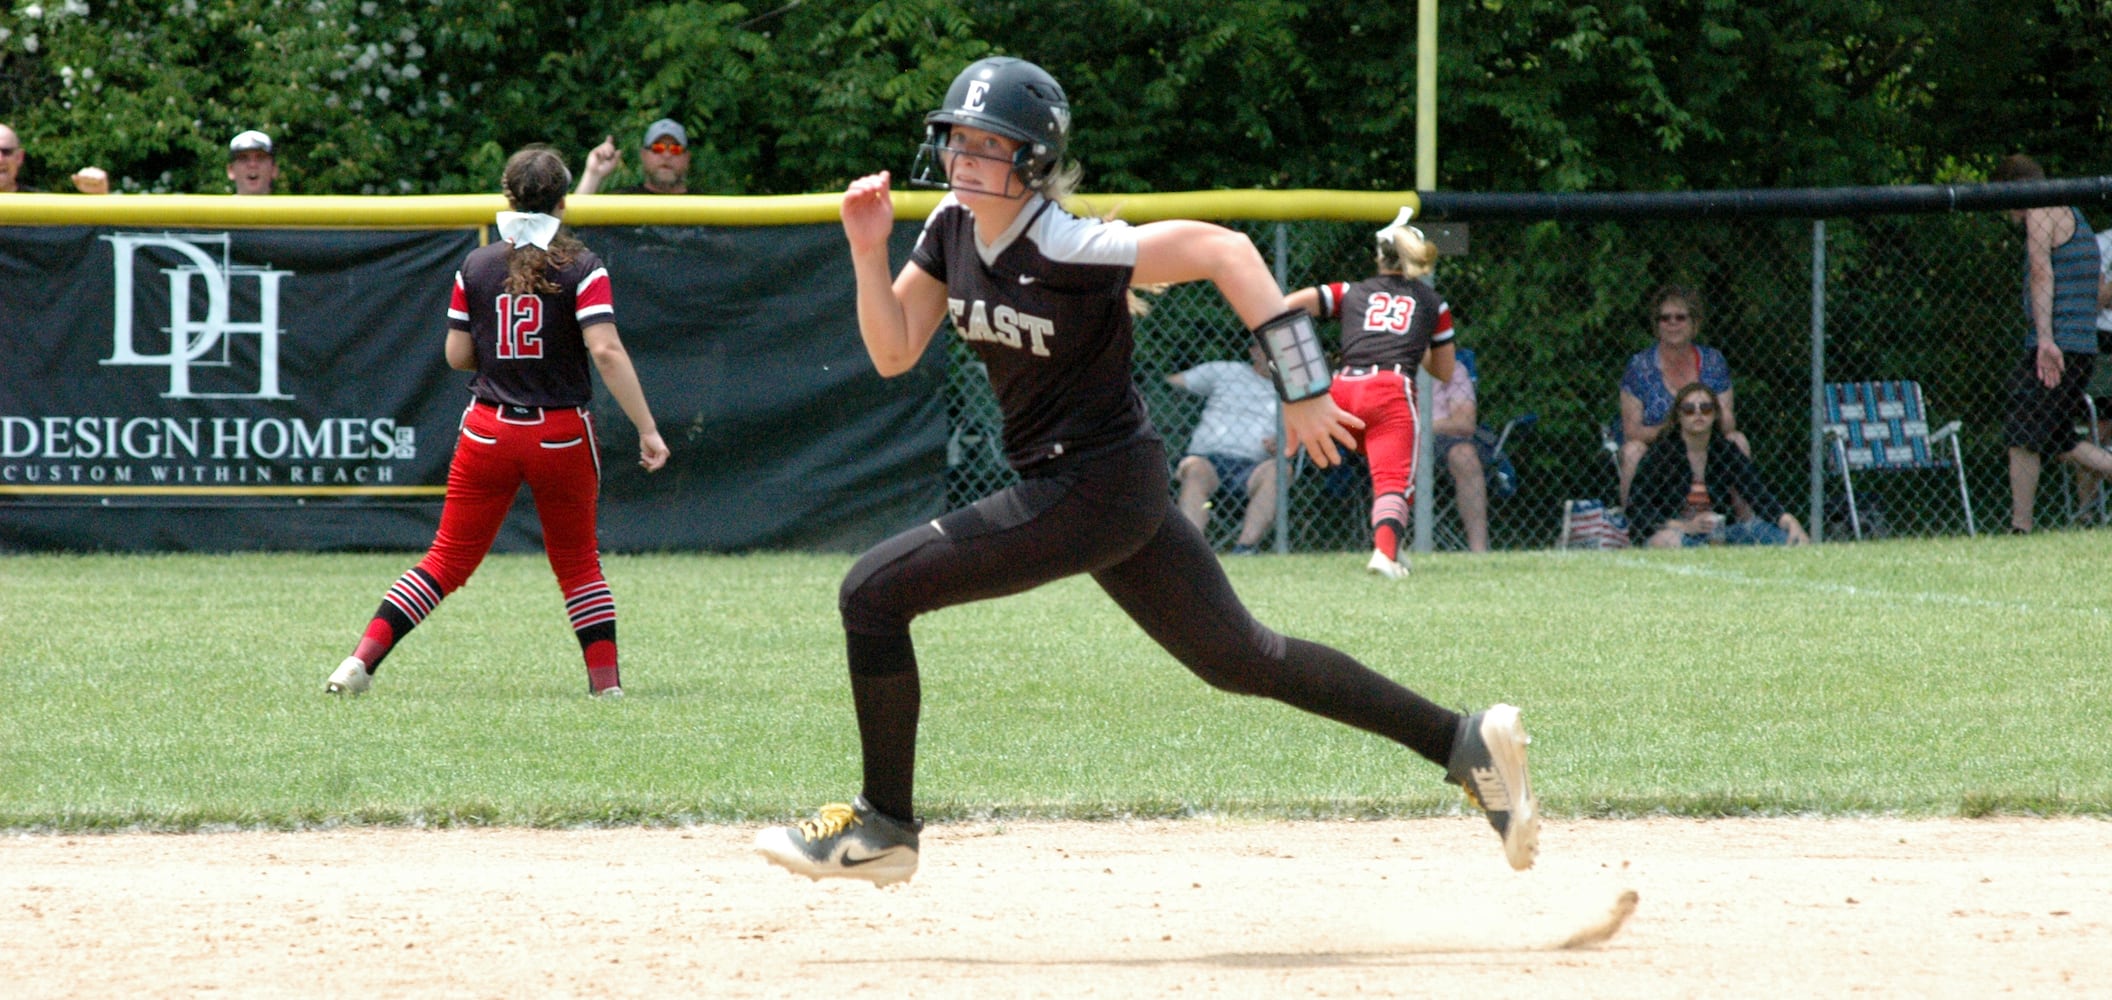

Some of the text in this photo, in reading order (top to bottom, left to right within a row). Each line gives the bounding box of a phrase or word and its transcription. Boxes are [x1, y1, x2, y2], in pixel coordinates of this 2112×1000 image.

[961, 79, 990, 112] E
[99, 231, 295, 399] DH
[496, 293, 544, 359] 12
[947, 297, 1055, 357] EAST
[1363, 291, 1416, 335] 23
[0, 416, 201, 459] DESIGN
[210, 417, 396, 460] HOMES
[3, 464, 393, 482] CUSTOM WITHIN REACH
